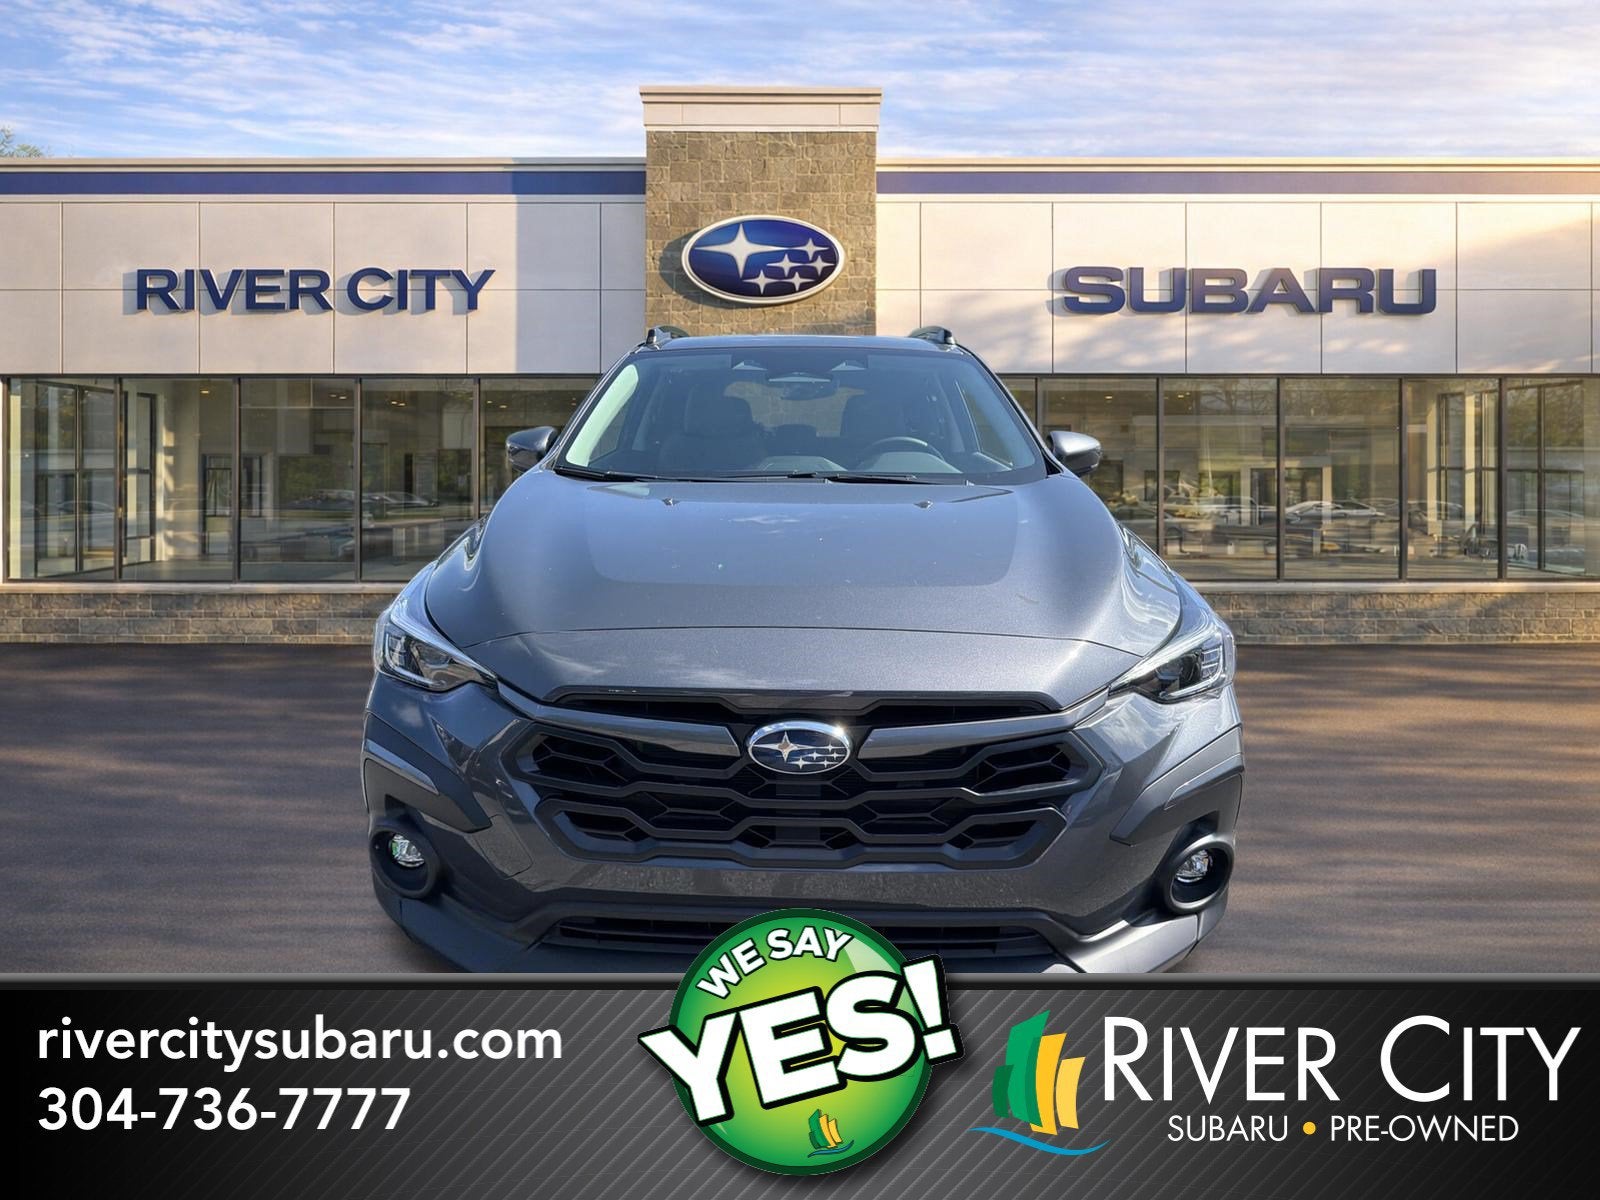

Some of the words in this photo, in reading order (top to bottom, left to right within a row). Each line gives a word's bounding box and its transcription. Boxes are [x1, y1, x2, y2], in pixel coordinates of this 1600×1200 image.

[136, 268, 335, 312] RIVER
[346, 267, 496, 312] CITY
[1063, 266, 1437, 315] SUBARU
